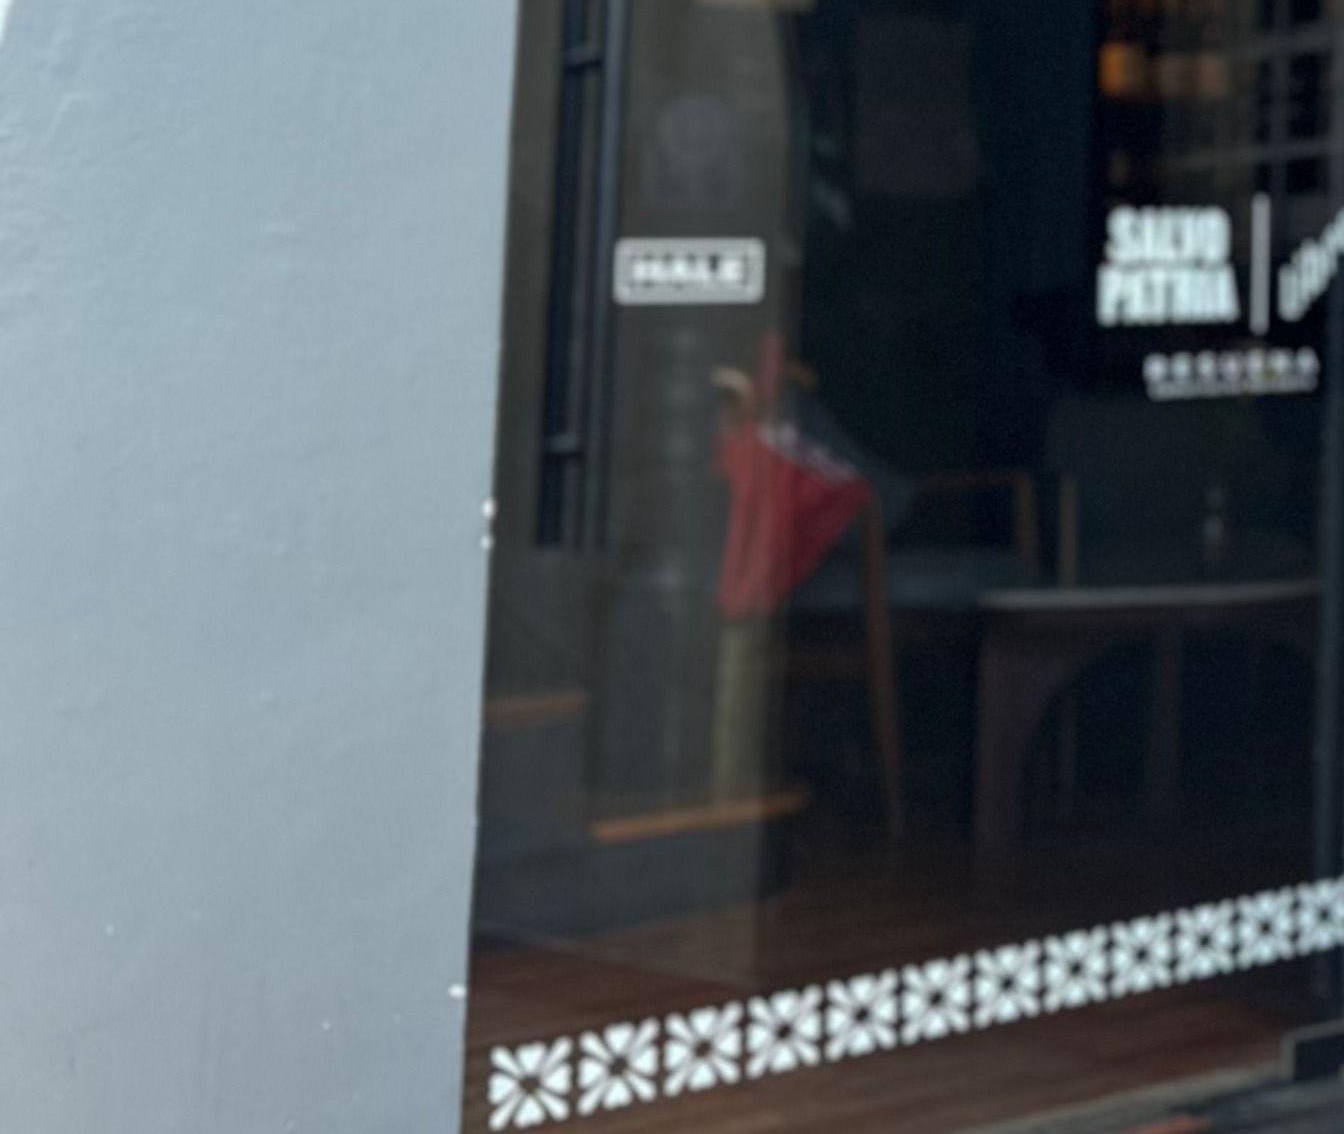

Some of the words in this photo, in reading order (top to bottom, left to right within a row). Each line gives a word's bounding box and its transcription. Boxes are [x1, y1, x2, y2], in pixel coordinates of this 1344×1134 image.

[1106, 206, 1231, 263] SALVO
[630, 253, 746, 287] HALE
[1098, 264, 1239, 324] PATRIA
